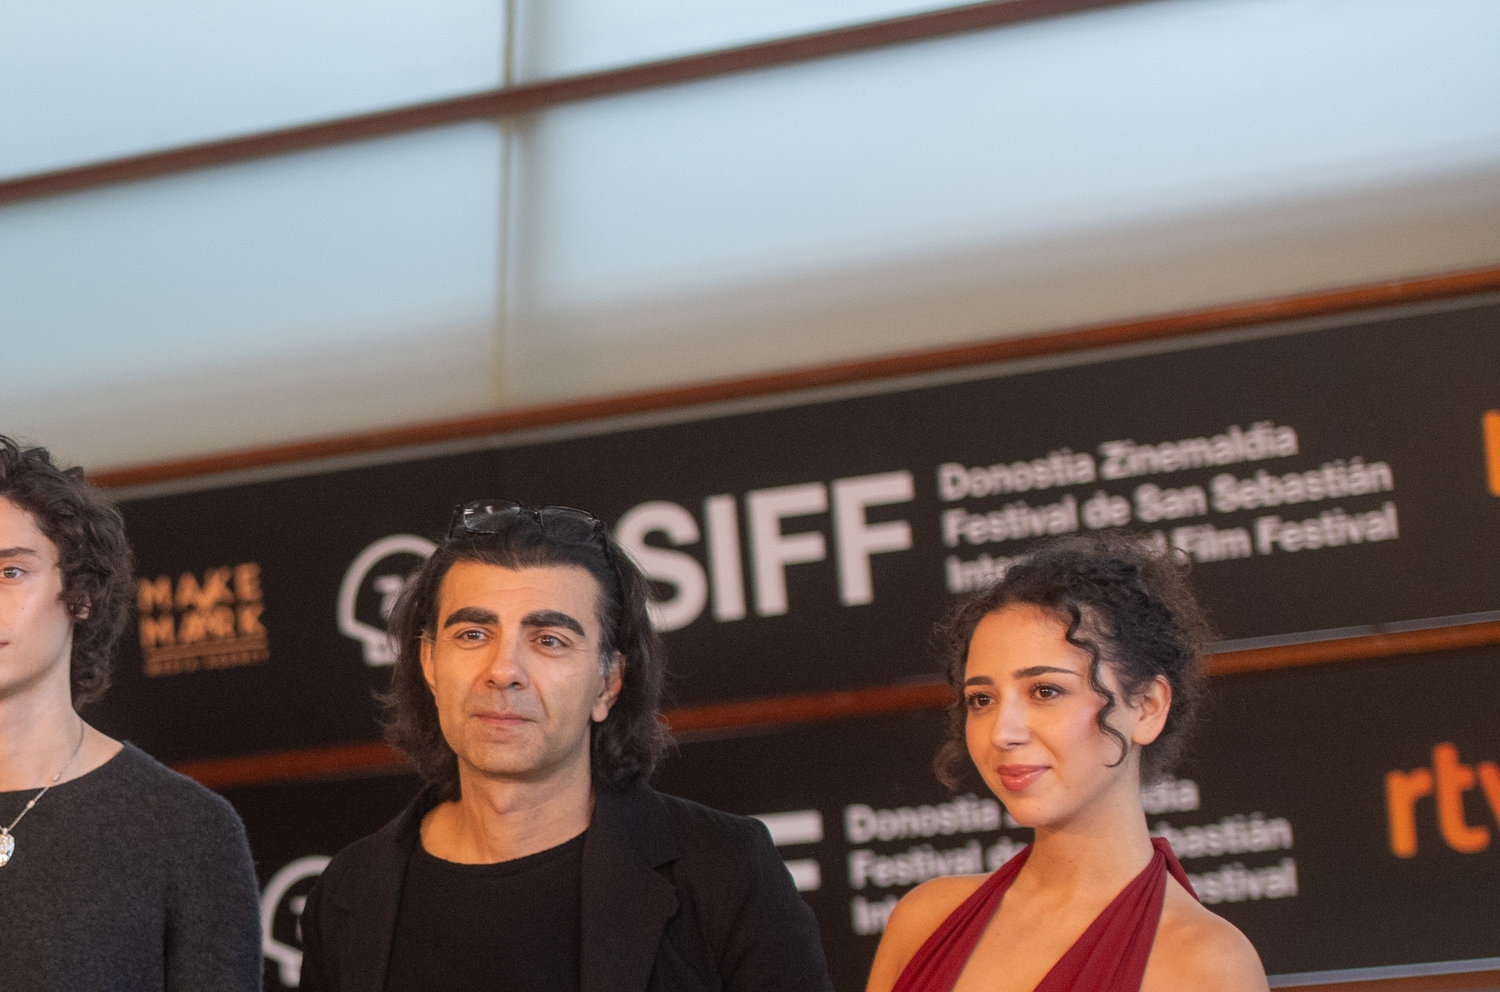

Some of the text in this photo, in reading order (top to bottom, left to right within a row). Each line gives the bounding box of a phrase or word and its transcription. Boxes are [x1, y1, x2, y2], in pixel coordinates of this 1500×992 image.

[937, 420, 1300, 502] Donostia Zinemaldia
[942, 455, 1395, 548] Festival de San Sebastián
[614, 469, 915, 633] SIFF
[1254, 500, 1400, 556] Festival
[844, 793, 1001, 844] Donostia
[1386, 742, 1500, 858] rt
[847, 838, 983, 891] Festival
